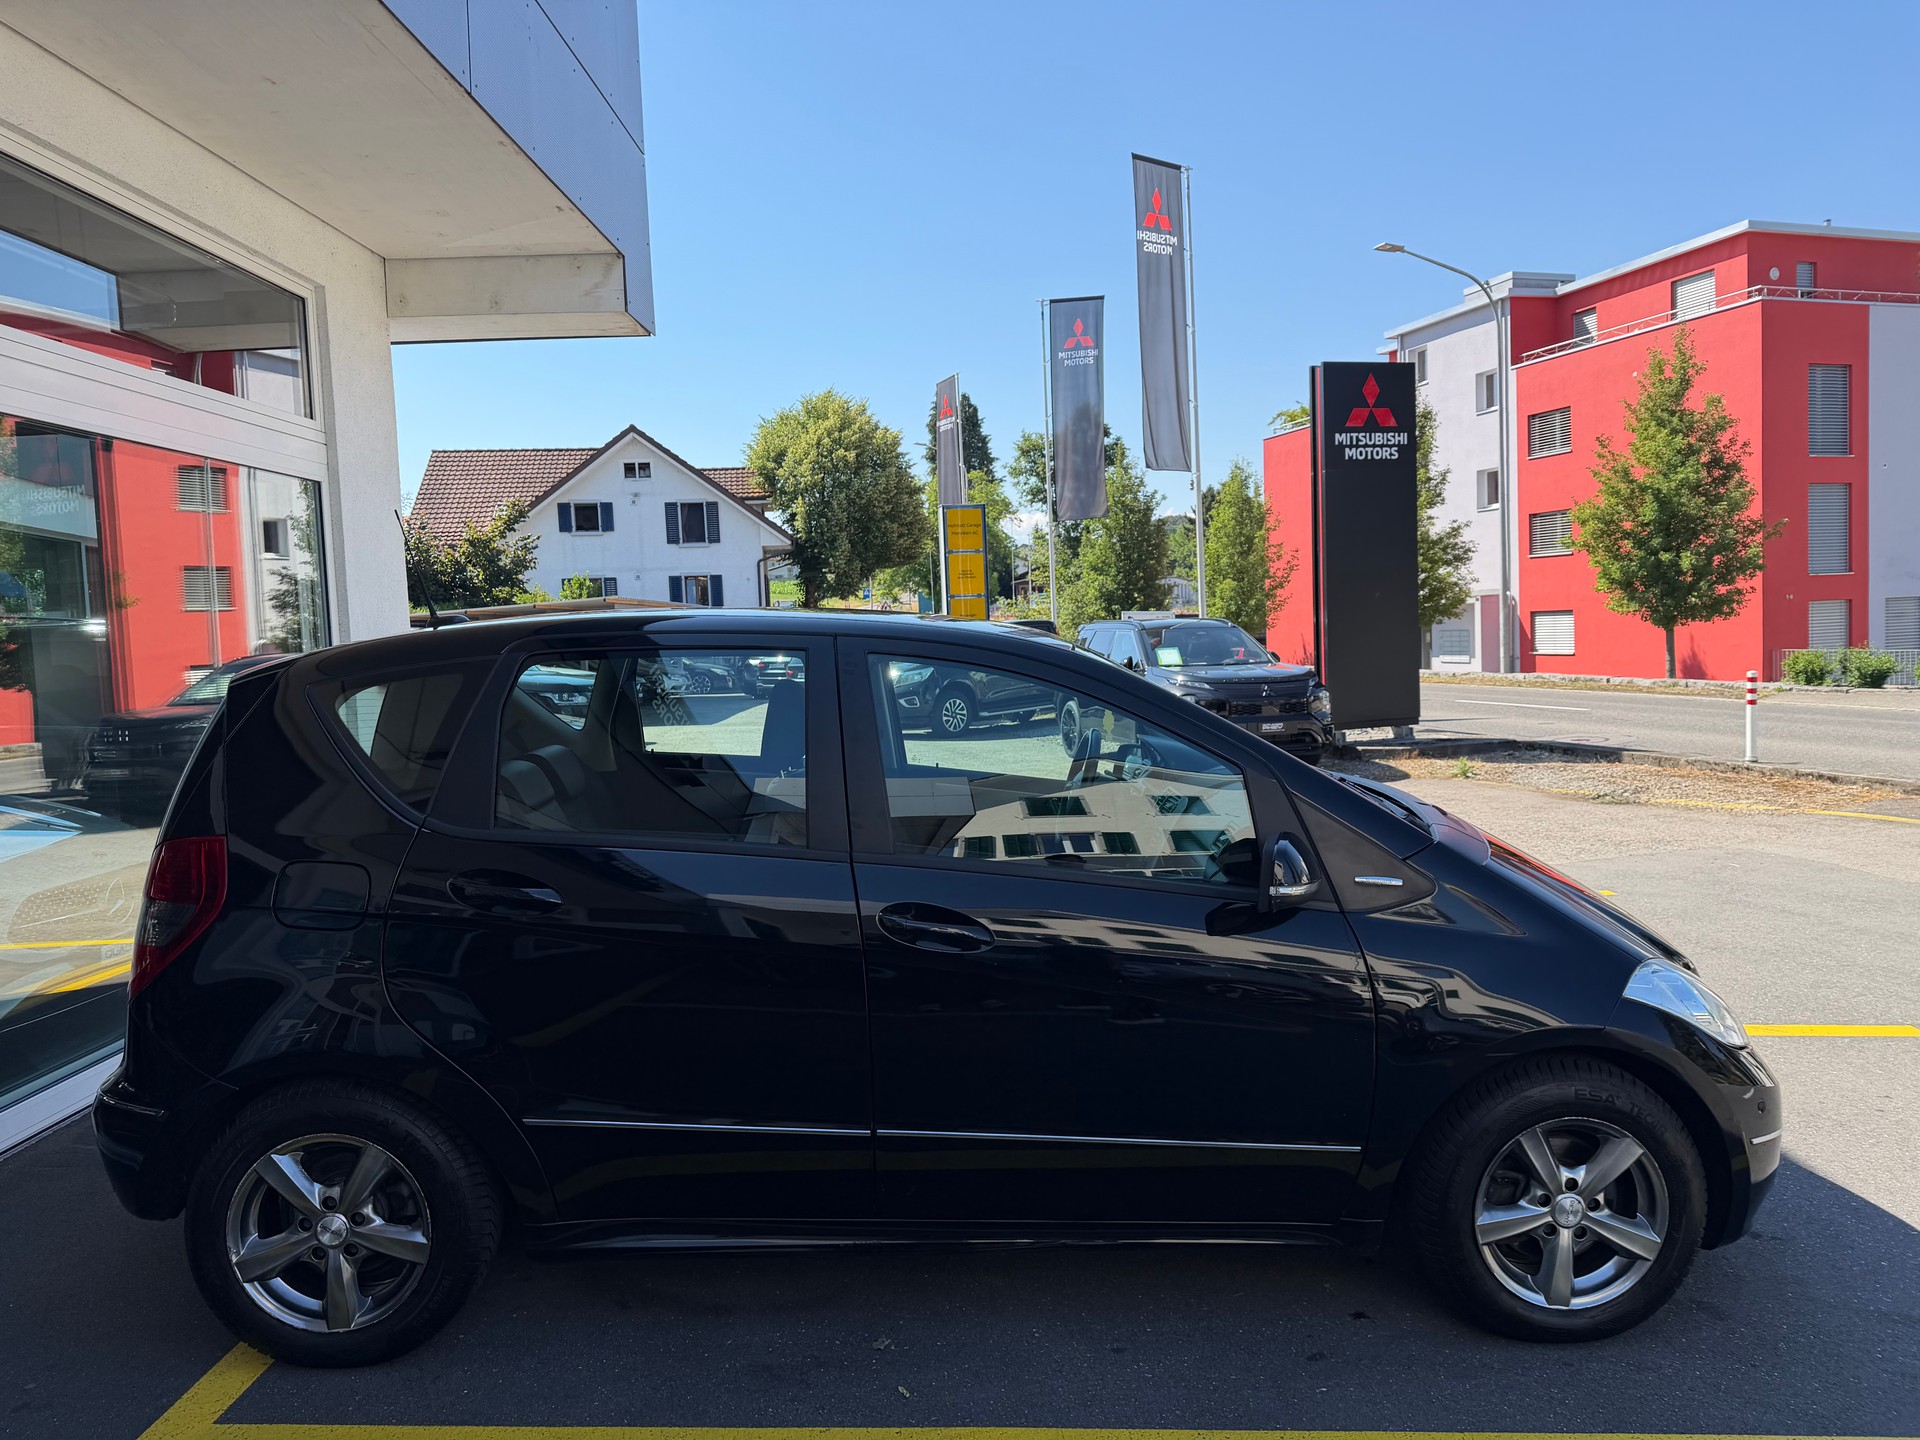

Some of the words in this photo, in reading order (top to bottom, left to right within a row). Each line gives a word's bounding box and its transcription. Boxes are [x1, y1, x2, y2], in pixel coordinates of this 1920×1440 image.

[1058, 348, 1099, 359] MITSUBISHI
[1064, 356, 1094, 367] MOTORS
[1334, 432, 1408, 446] MITSUBISHI
[1344, 446, 1399, 460] MOTORS
